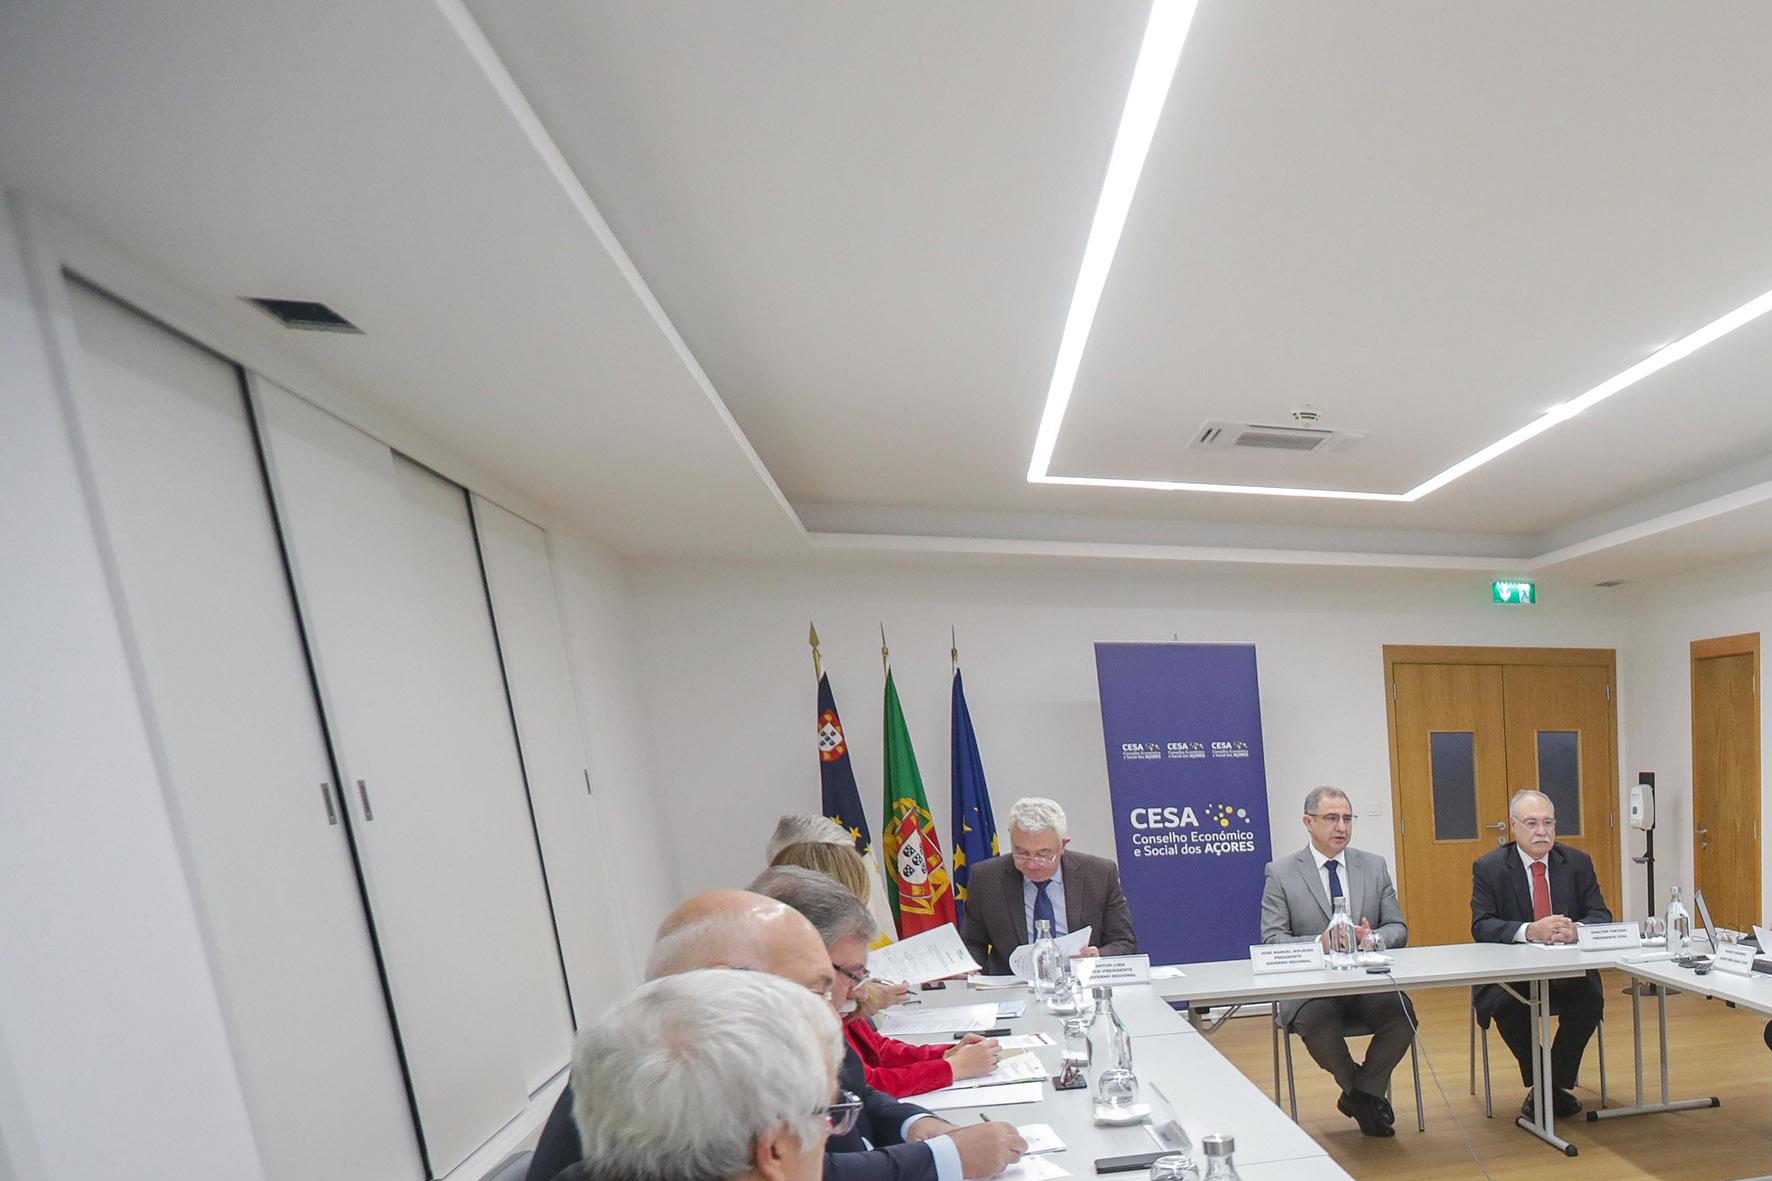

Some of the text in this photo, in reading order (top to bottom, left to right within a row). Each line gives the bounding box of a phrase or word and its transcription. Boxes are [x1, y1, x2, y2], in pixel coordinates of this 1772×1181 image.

[1122, 743, 1144, 751] CESA
[1167, 742, 1188, 750] CESA
[1211, 741, 1232, 750] CESA
[1130, 807, 1199, 829] CESA
[1132, 830, 1254, 845] Conselho Económico
[1134, 841, 1255, 857] e Social dos AÇORES
